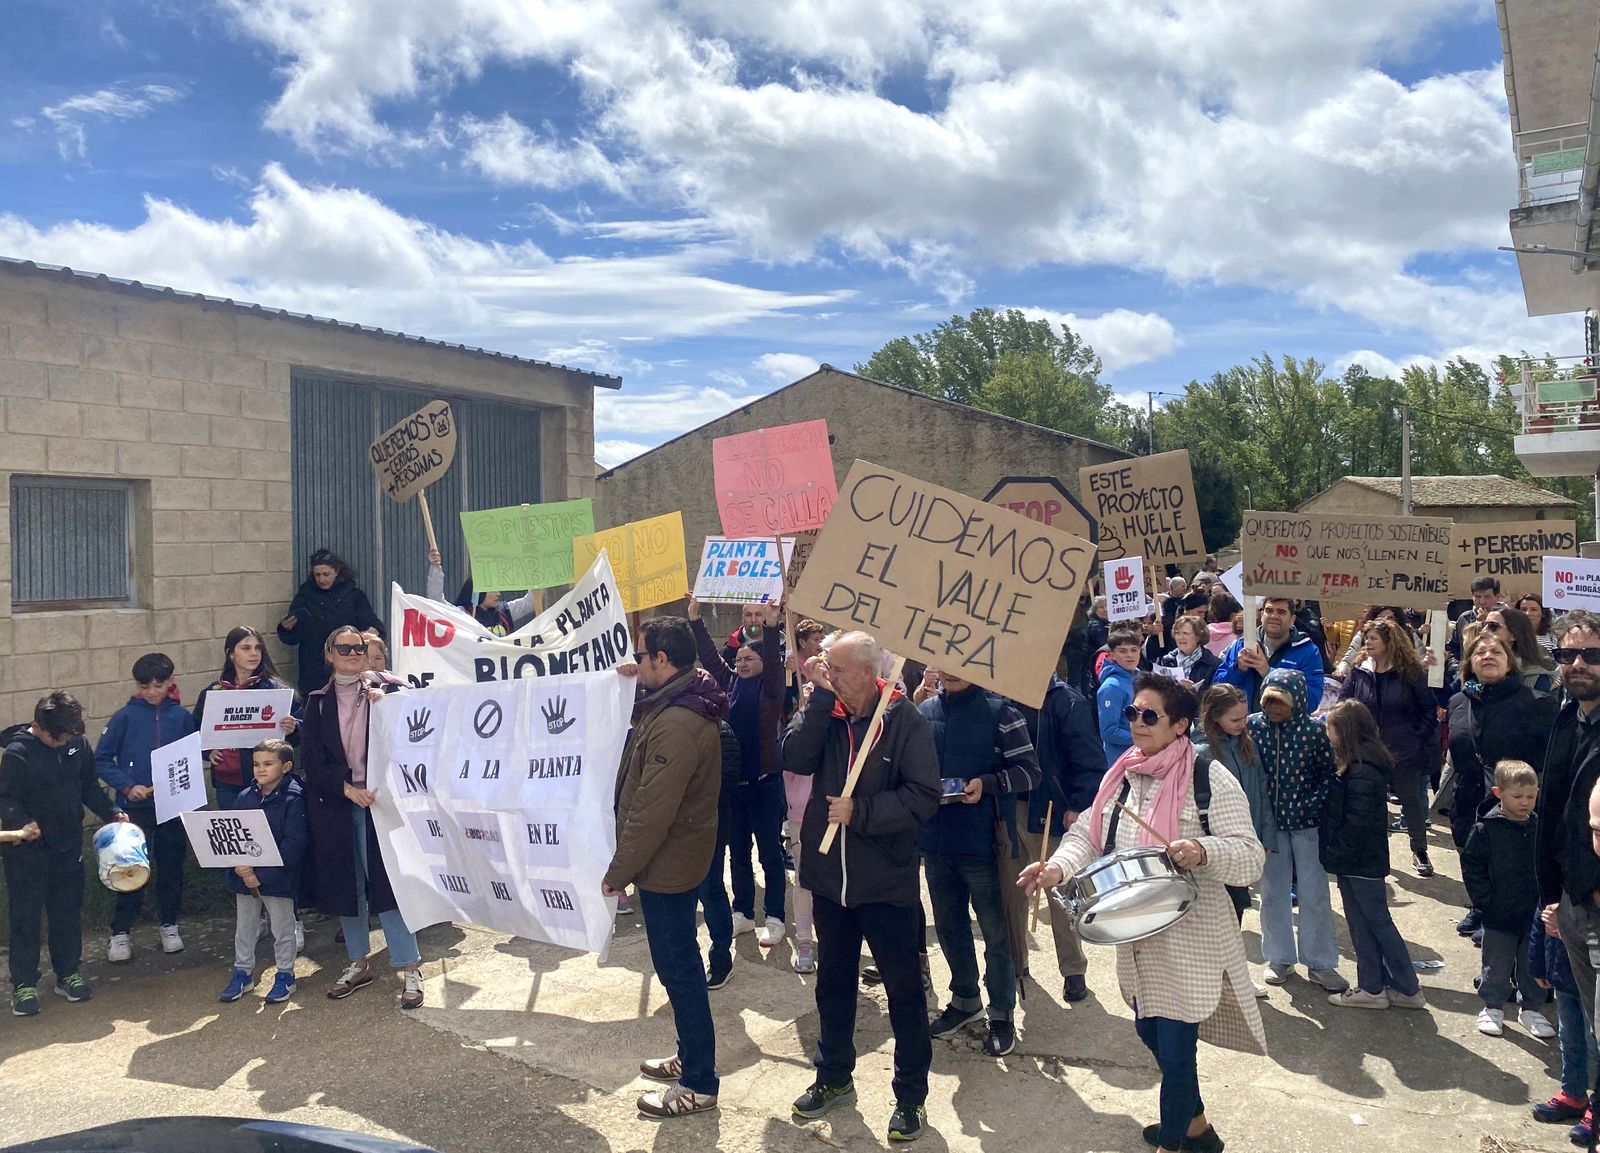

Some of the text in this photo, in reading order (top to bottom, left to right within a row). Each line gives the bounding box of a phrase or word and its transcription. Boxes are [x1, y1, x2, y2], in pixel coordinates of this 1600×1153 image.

[371, 414, 430, 464] QUEREMOS
[743, 457, 784, 498] NO
[1089, 467, 1132, 492] ESTE
[1097, 485, 1184, 518] PROYECTO
[500, 512, 586, 543] PUESTOS
[725, 499, 757, 534] SE
[1122, 511, 1186, 539] HUELE
[1245, 519, 1312, 538] QUEREMOS
[1320, 523, 1383, 540] PROYECTOS
[629, 522, 669, 561] NO
[850, 474, 1086, 591] CUIDEMOS
[707, 542, 768, 558] PLANTA
[1143, 533, 1198, 560] MAL
[1276, 544, 1443, 564] NO QUE NOS LLENEN EL
[476, 550, 574, 588] TRABAJ
[1252, 569, 1301, 586] VALLE
[1322, 573, 1359, 588] TERA
[1367, 577, 1385, 589] DE
[1555, 571, 1573, 584] NO
[856, 542, 898, 588] EL
[936, 560, 1032, 635] VALLE
[1111, 590, 1139, 605] STOP
[402, 608, 456, 648] NO
[555, 582, 610, 636] PLANTA
[820, 582, 996, 679] DEL TERA
[474, 622, 628, 683] BIOMETANO
[223, 714, 252, 722] A HACER
[224, 707, 234, 715] NO
[245, 706, 260, 714] VAN
[548, 717, 564, 730] STOP
[410, 728, 426, 739] STOP
[177, 756, 191, 791] STOP
[399, 755, 582, 794] NO A LA PLANTA
[206, 827, 254, 842] HUELE
[209, 818, 243, 830] ESTO
[426, 819, 444, 838] DE
[527, 823, 541, 845] EN
[545, 823, 560, 845] EL
[209, 840, 247, 856] MAL
[439, 873, 574, 911] VALLE DEL TERA
